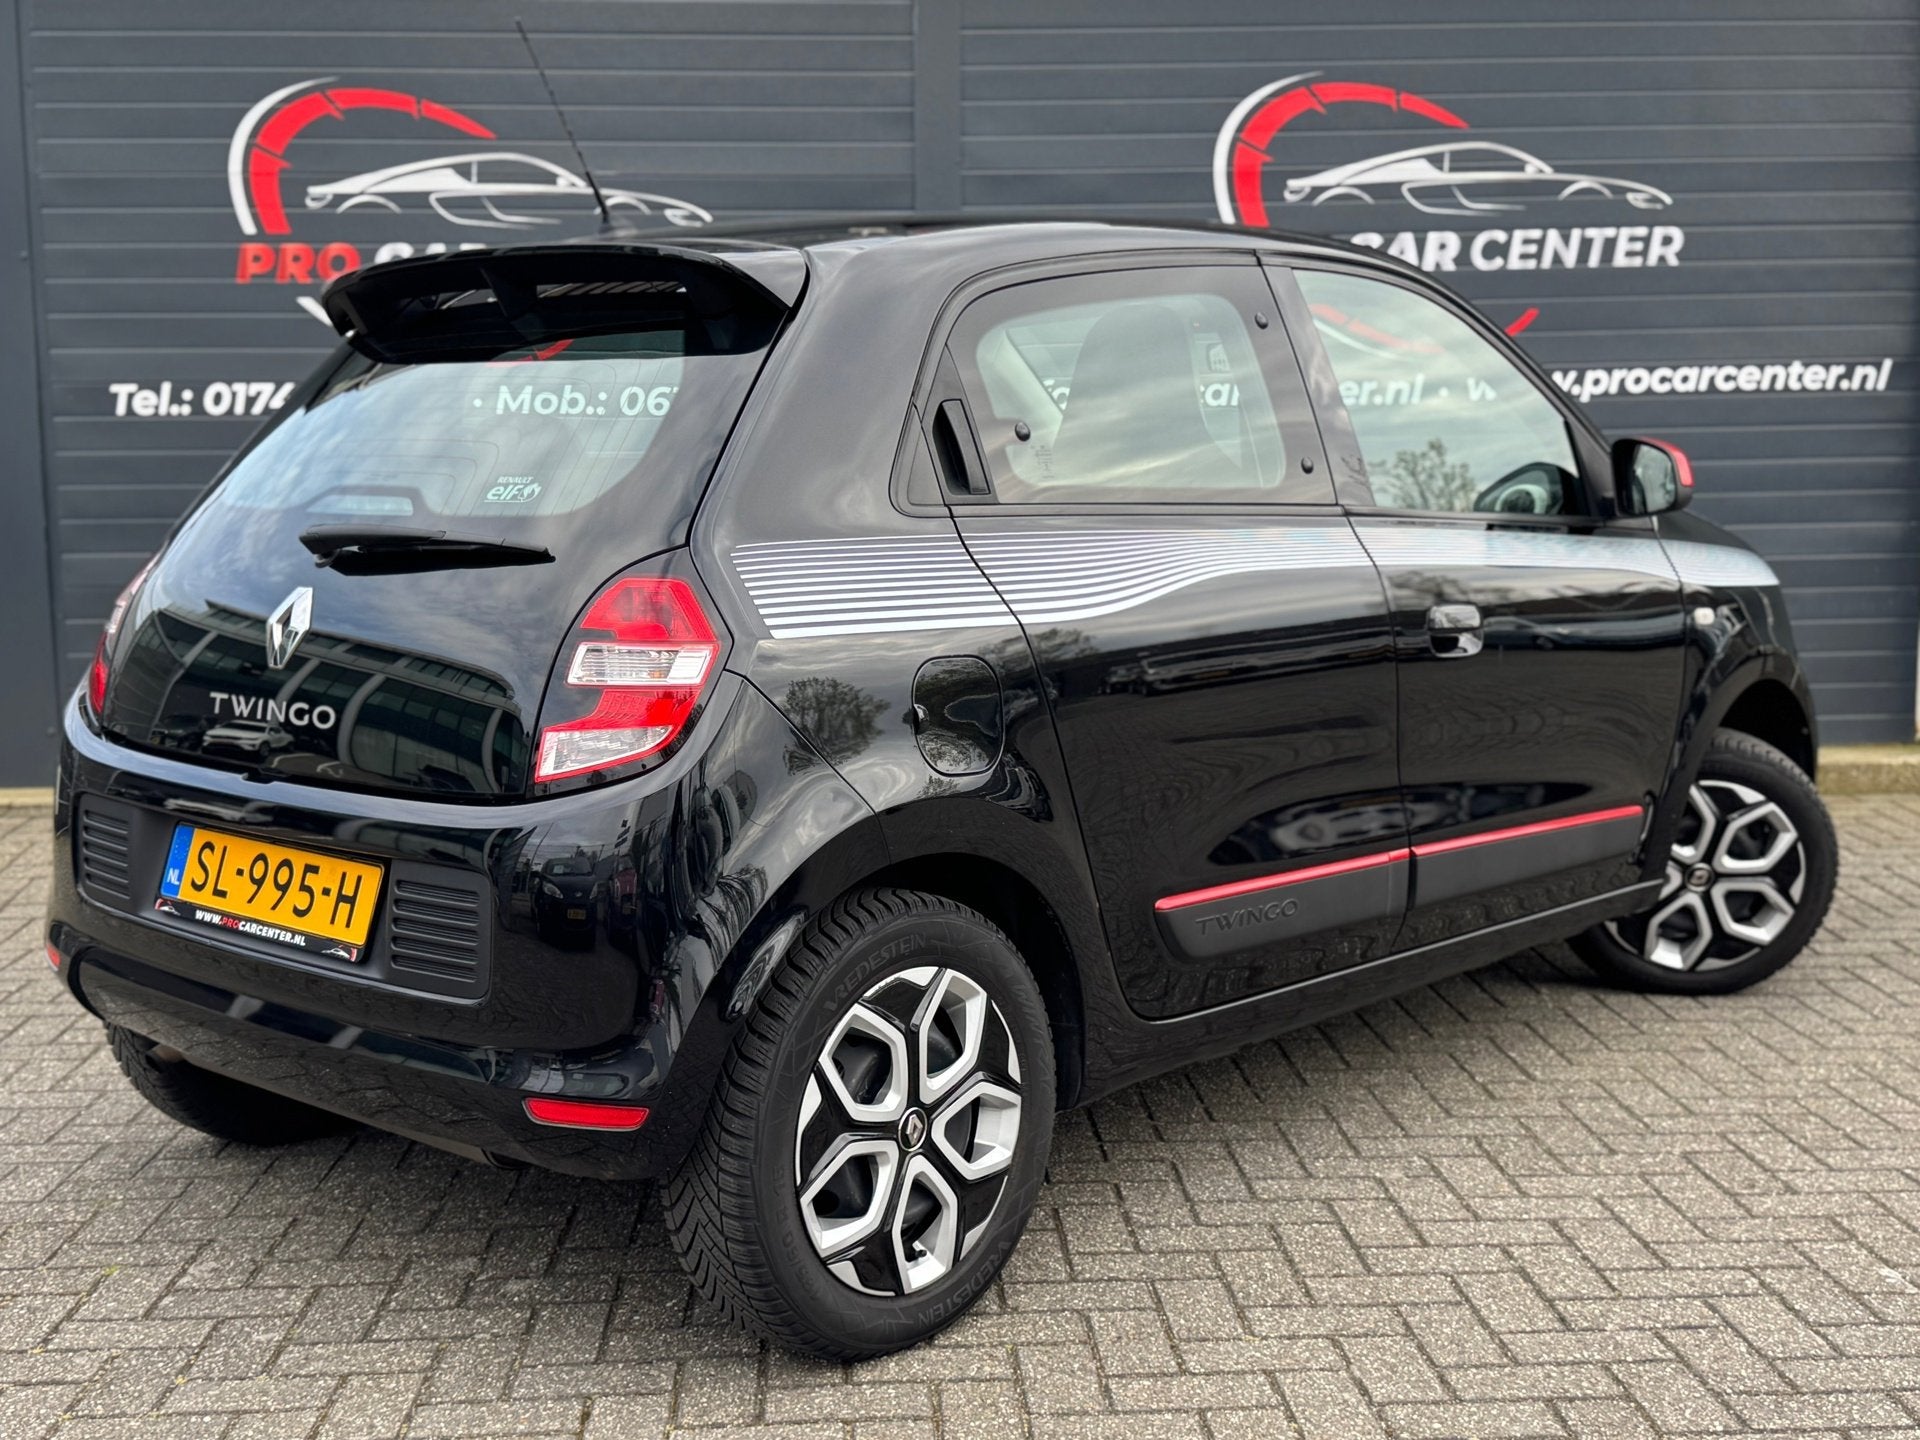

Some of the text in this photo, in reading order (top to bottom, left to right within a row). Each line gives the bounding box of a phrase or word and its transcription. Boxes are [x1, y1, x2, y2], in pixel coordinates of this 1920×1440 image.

[234, 242, 361, 284] PRO
[1469, 225, 1685, 271] CENTER
[108, 380, 194, 417] Tel.:
[495, 384, 608, 416] Mob.:
[619, 386, 679, 416] 06
[497, 475, 534, 484] RENAULT
[209, 691, 337, 730] TWINGO
[166, 867, 180, 886] NL
[190, 840, 363, 929] SL-995-H
[195, 909, 306, 947] WWW.PROCARCENTER.NL
[1195, 898, 1299, 936] TWINGO
[823, 932, 927, 1012] VREDESTEIN
